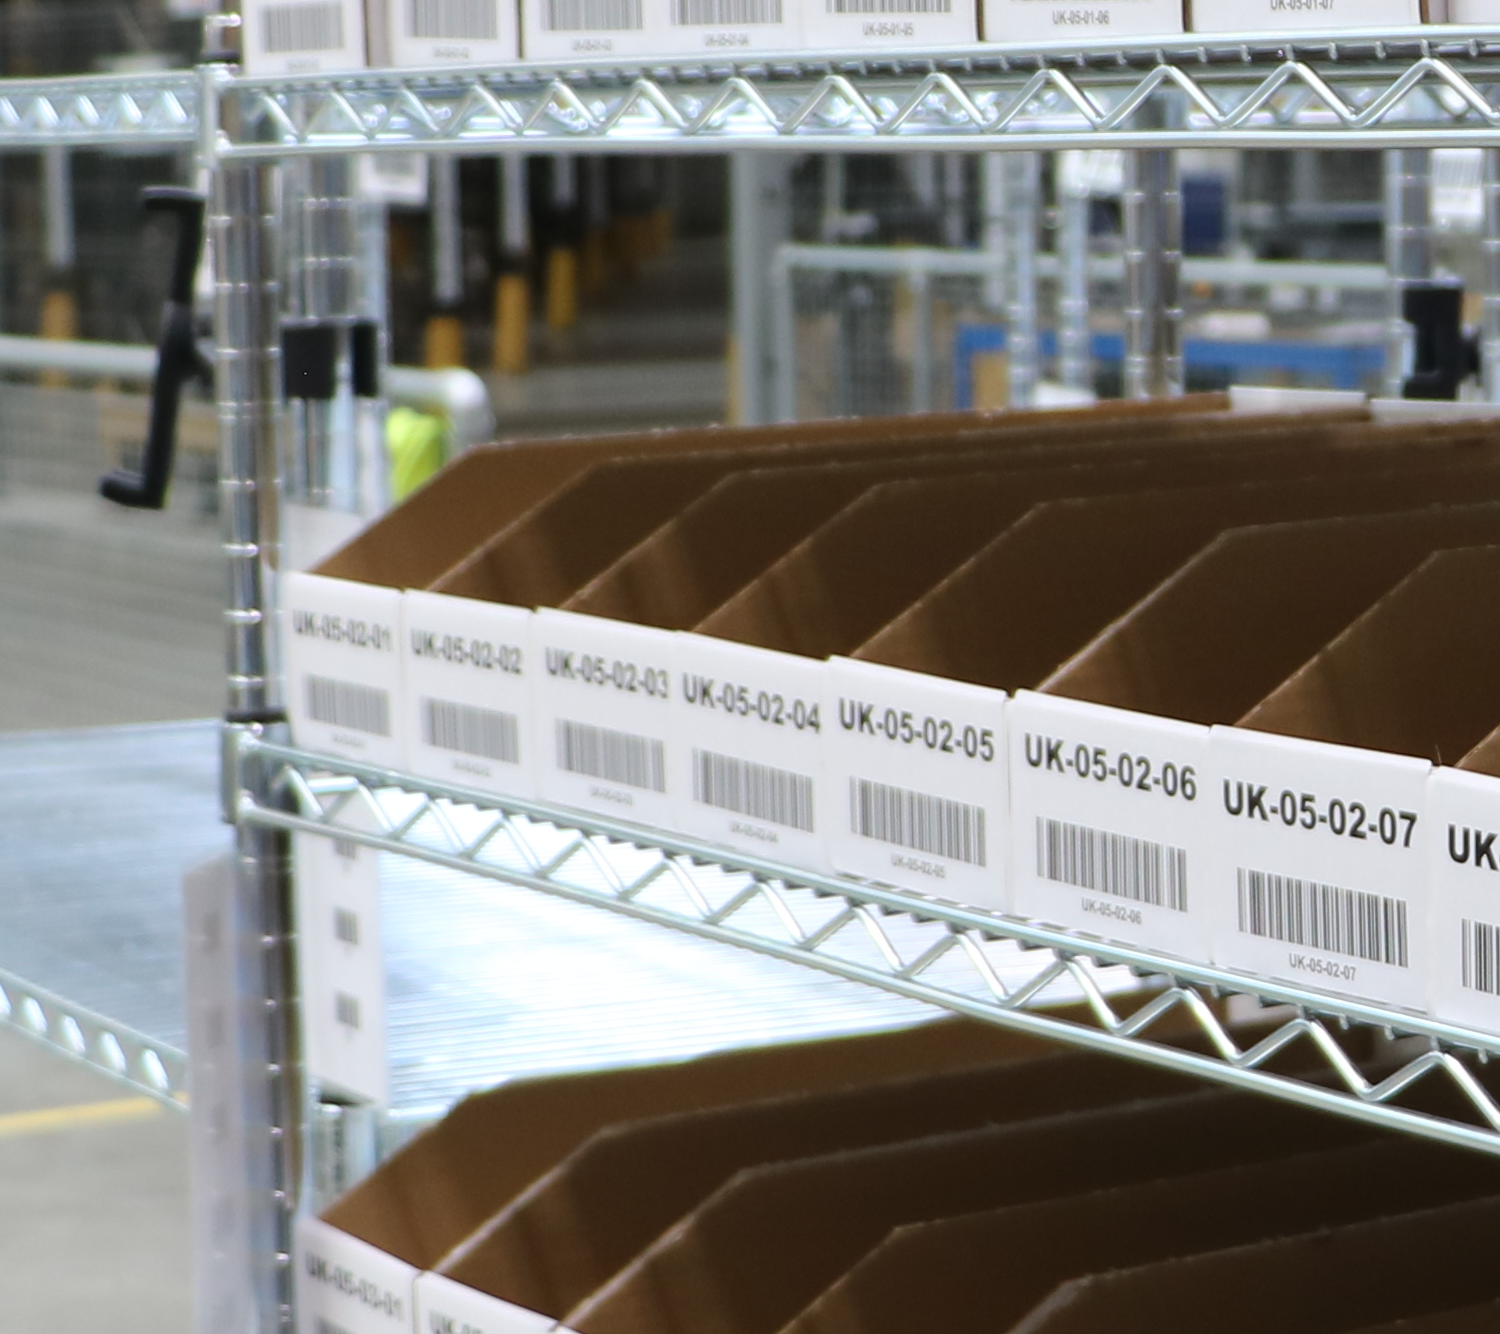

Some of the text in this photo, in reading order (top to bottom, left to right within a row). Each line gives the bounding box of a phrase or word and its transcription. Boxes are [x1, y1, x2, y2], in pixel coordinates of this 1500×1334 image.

[411, 632, 522, 676] UK-05-02-02
[545, 647, 669, 700] UK-05-02-03
[683, 674, 821, 734] UK-05-02-04
[839, 698, 995, 763] UK-05-02-05
[1025, 734, 1197, 802] UK-05-02-06
[1223, 780, 1418, 848] UK-05-02-07
[1288, 953, 1357, 982] UK-05-02-07
